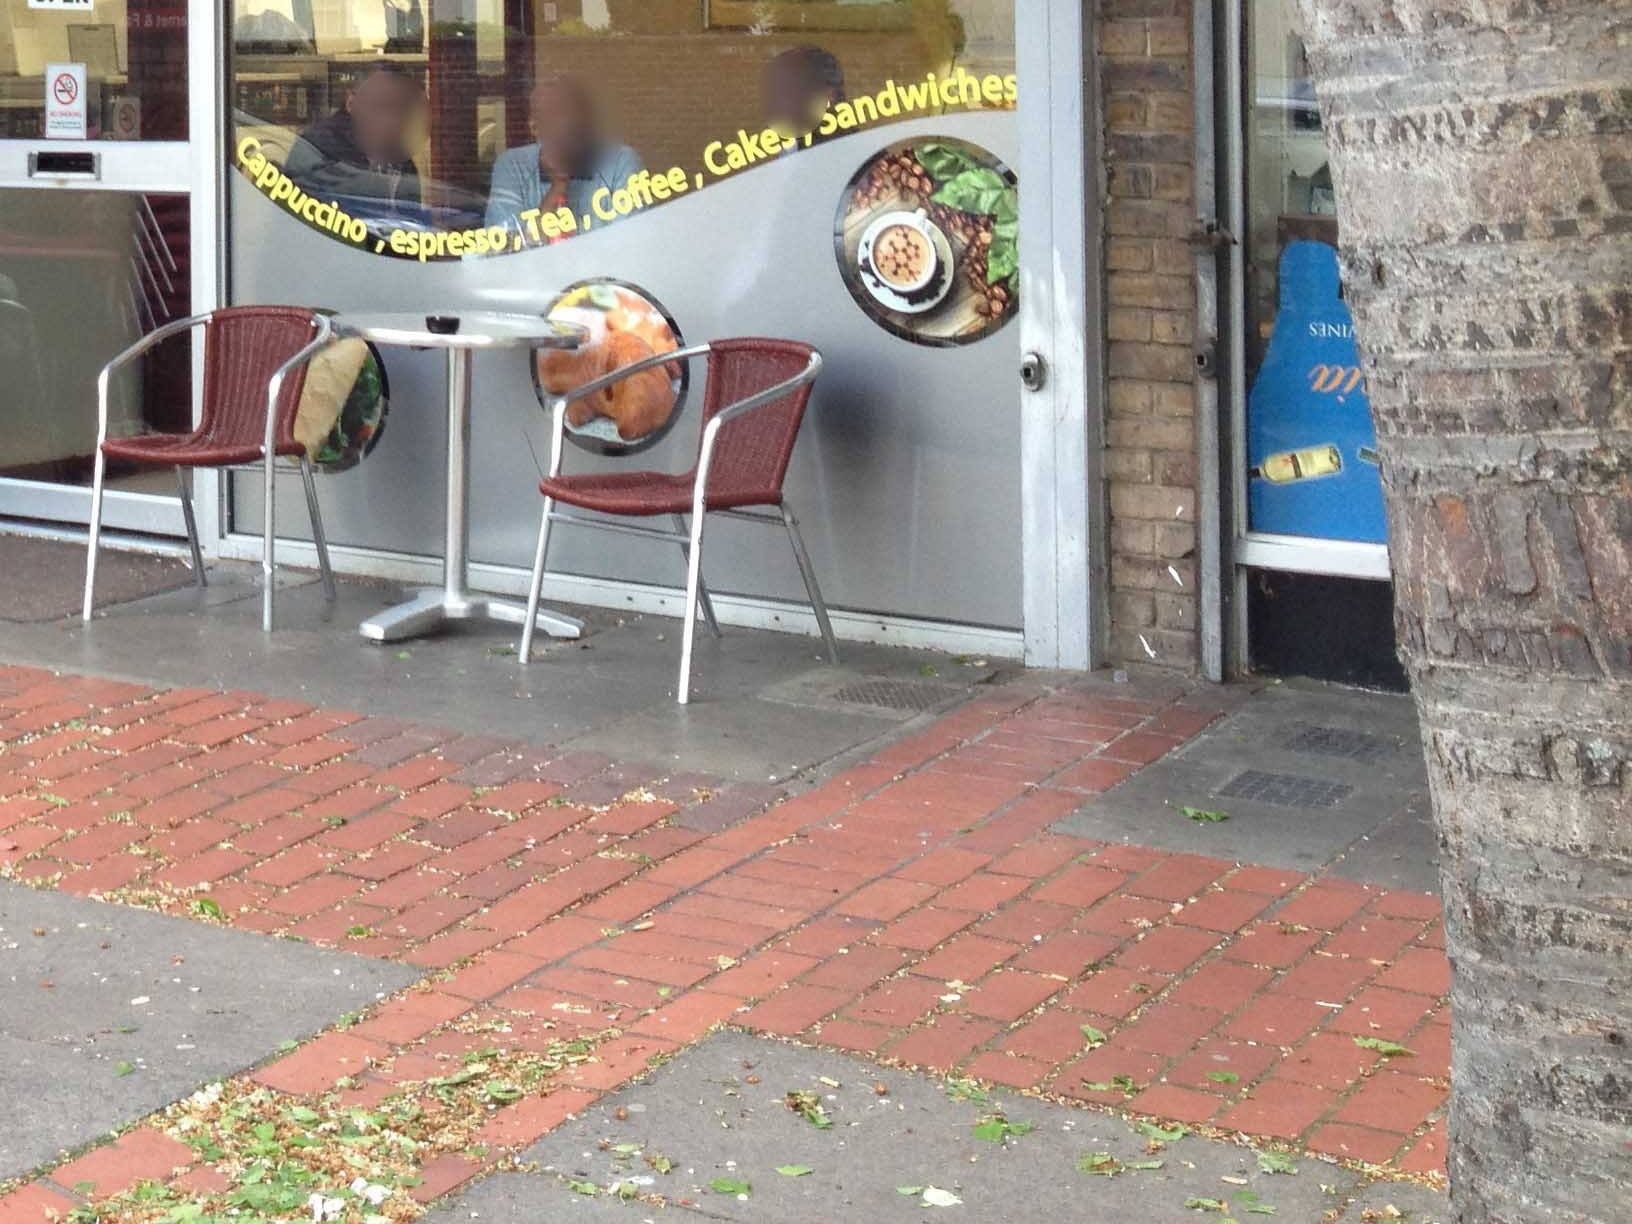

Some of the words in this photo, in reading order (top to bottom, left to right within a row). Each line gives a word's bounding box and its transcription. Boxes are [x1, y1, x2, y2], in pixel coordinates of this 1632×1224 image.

[237, 136, 368, 243] Cappuccino
[390, 227, 507, 263] espresso
[521, 205, 577, 241] Tea
[591, 166, 689, 221] Coffee
